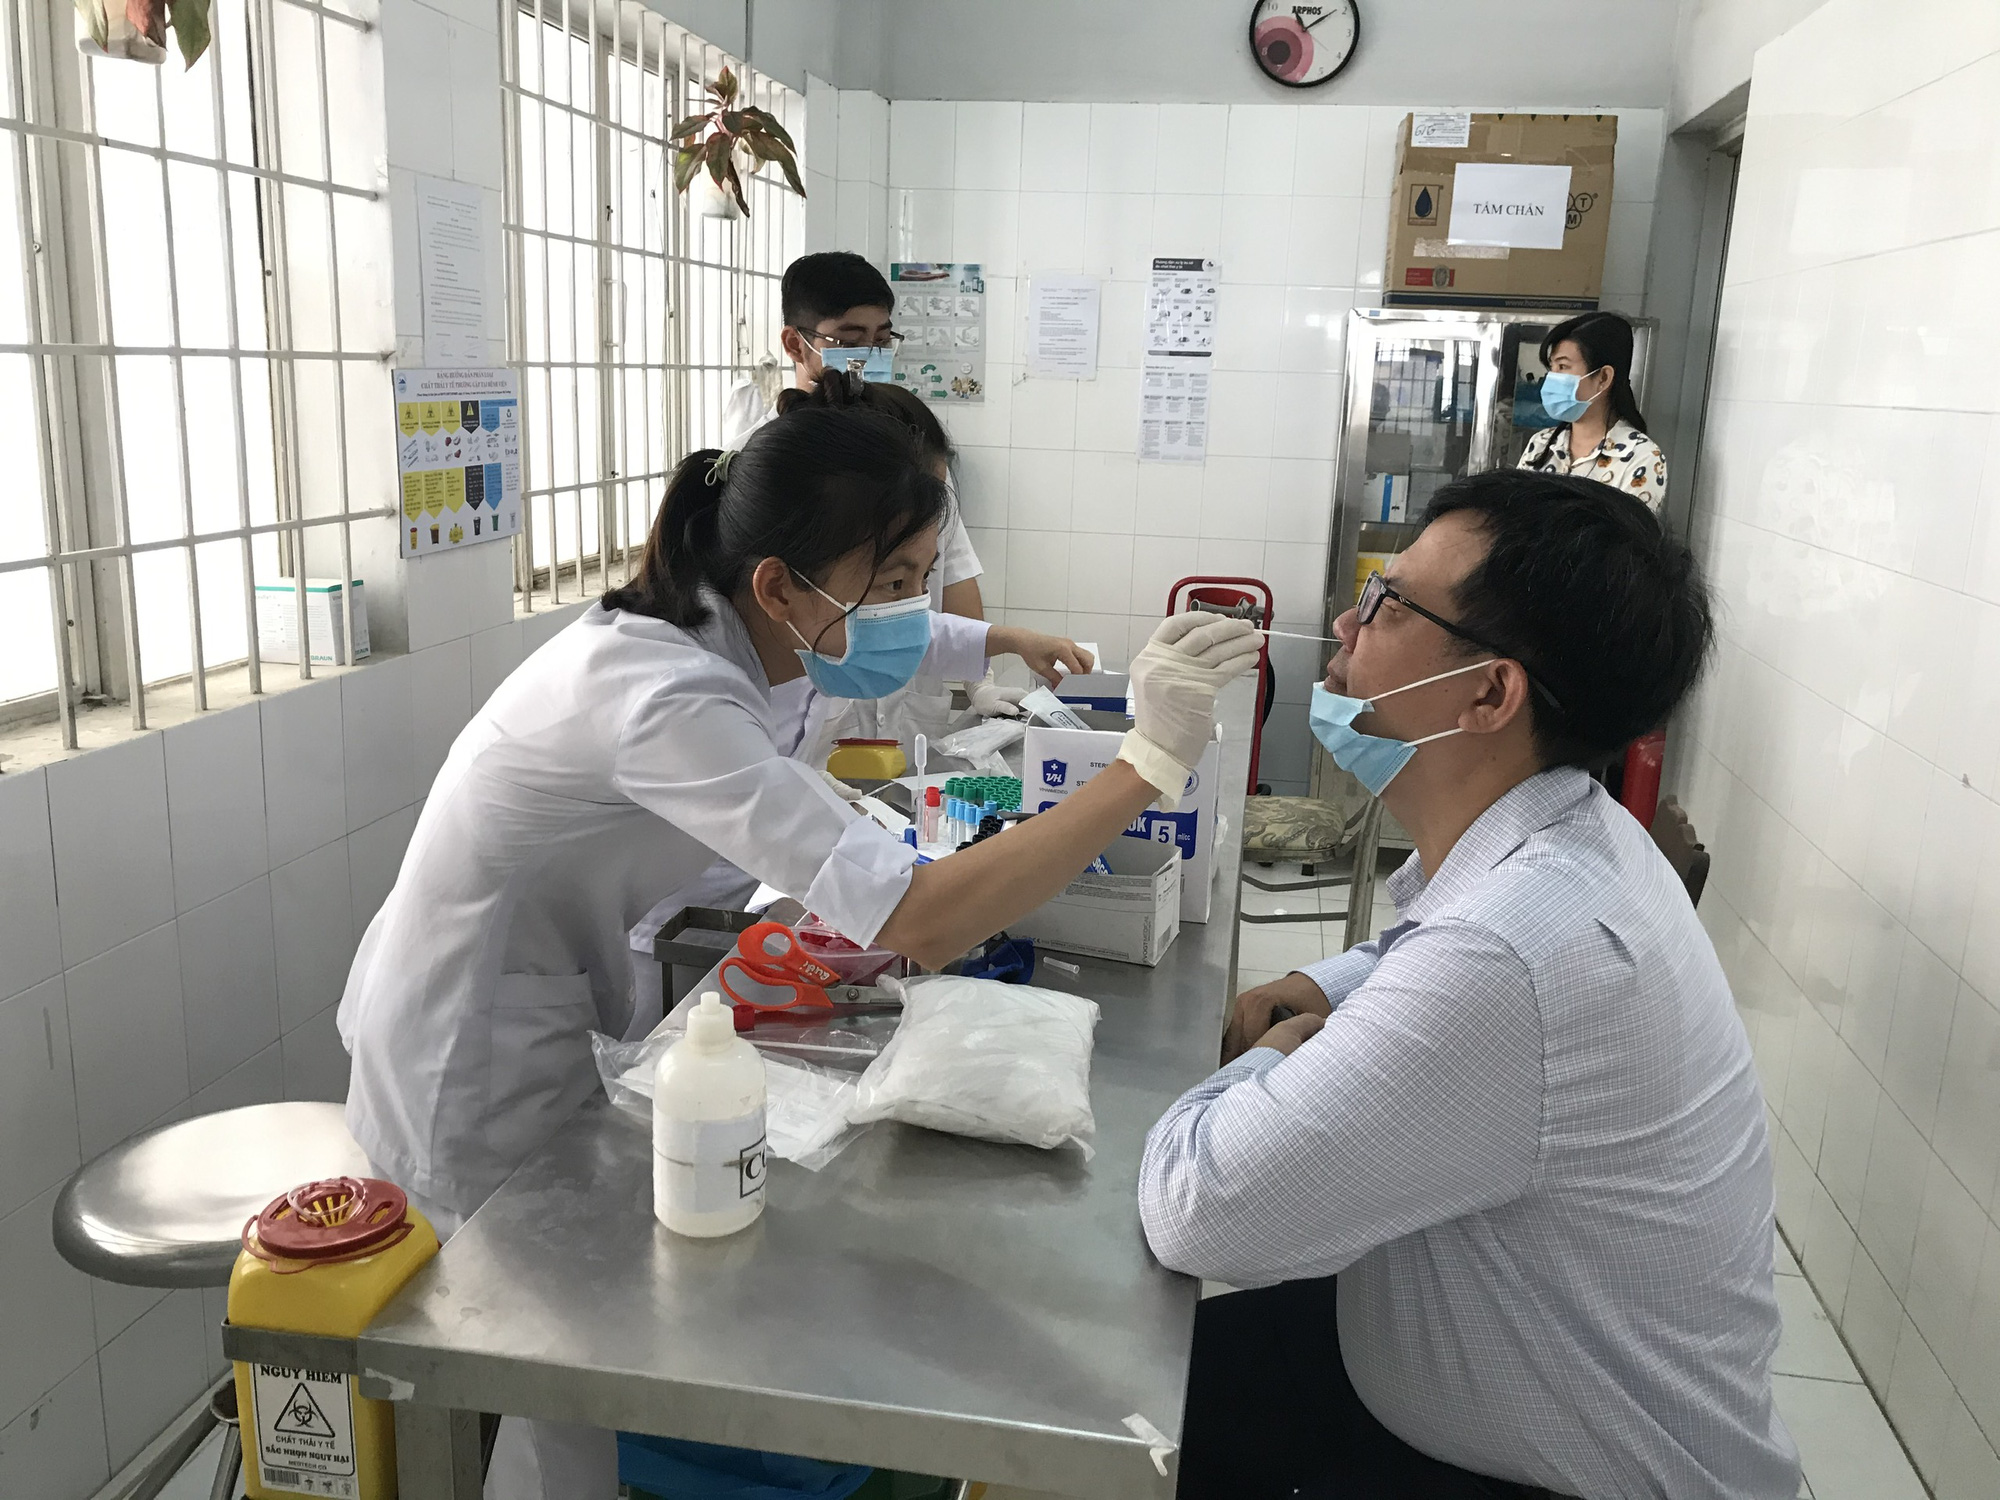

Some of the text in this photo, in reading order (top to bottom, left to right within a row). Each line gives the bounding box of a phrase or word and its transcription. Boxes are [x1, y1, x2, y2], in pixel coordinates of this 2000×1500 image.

[1291, 5, 1323, 15] ARPHOS
[1341, 6, 1347, 15] 2
[1347, 28, 1352, 38] 3
[1275, 64, 1282, 72] 7
[1158, 825, 1170, 844] 5
[260, 1364, 301, 1380] NGUY
